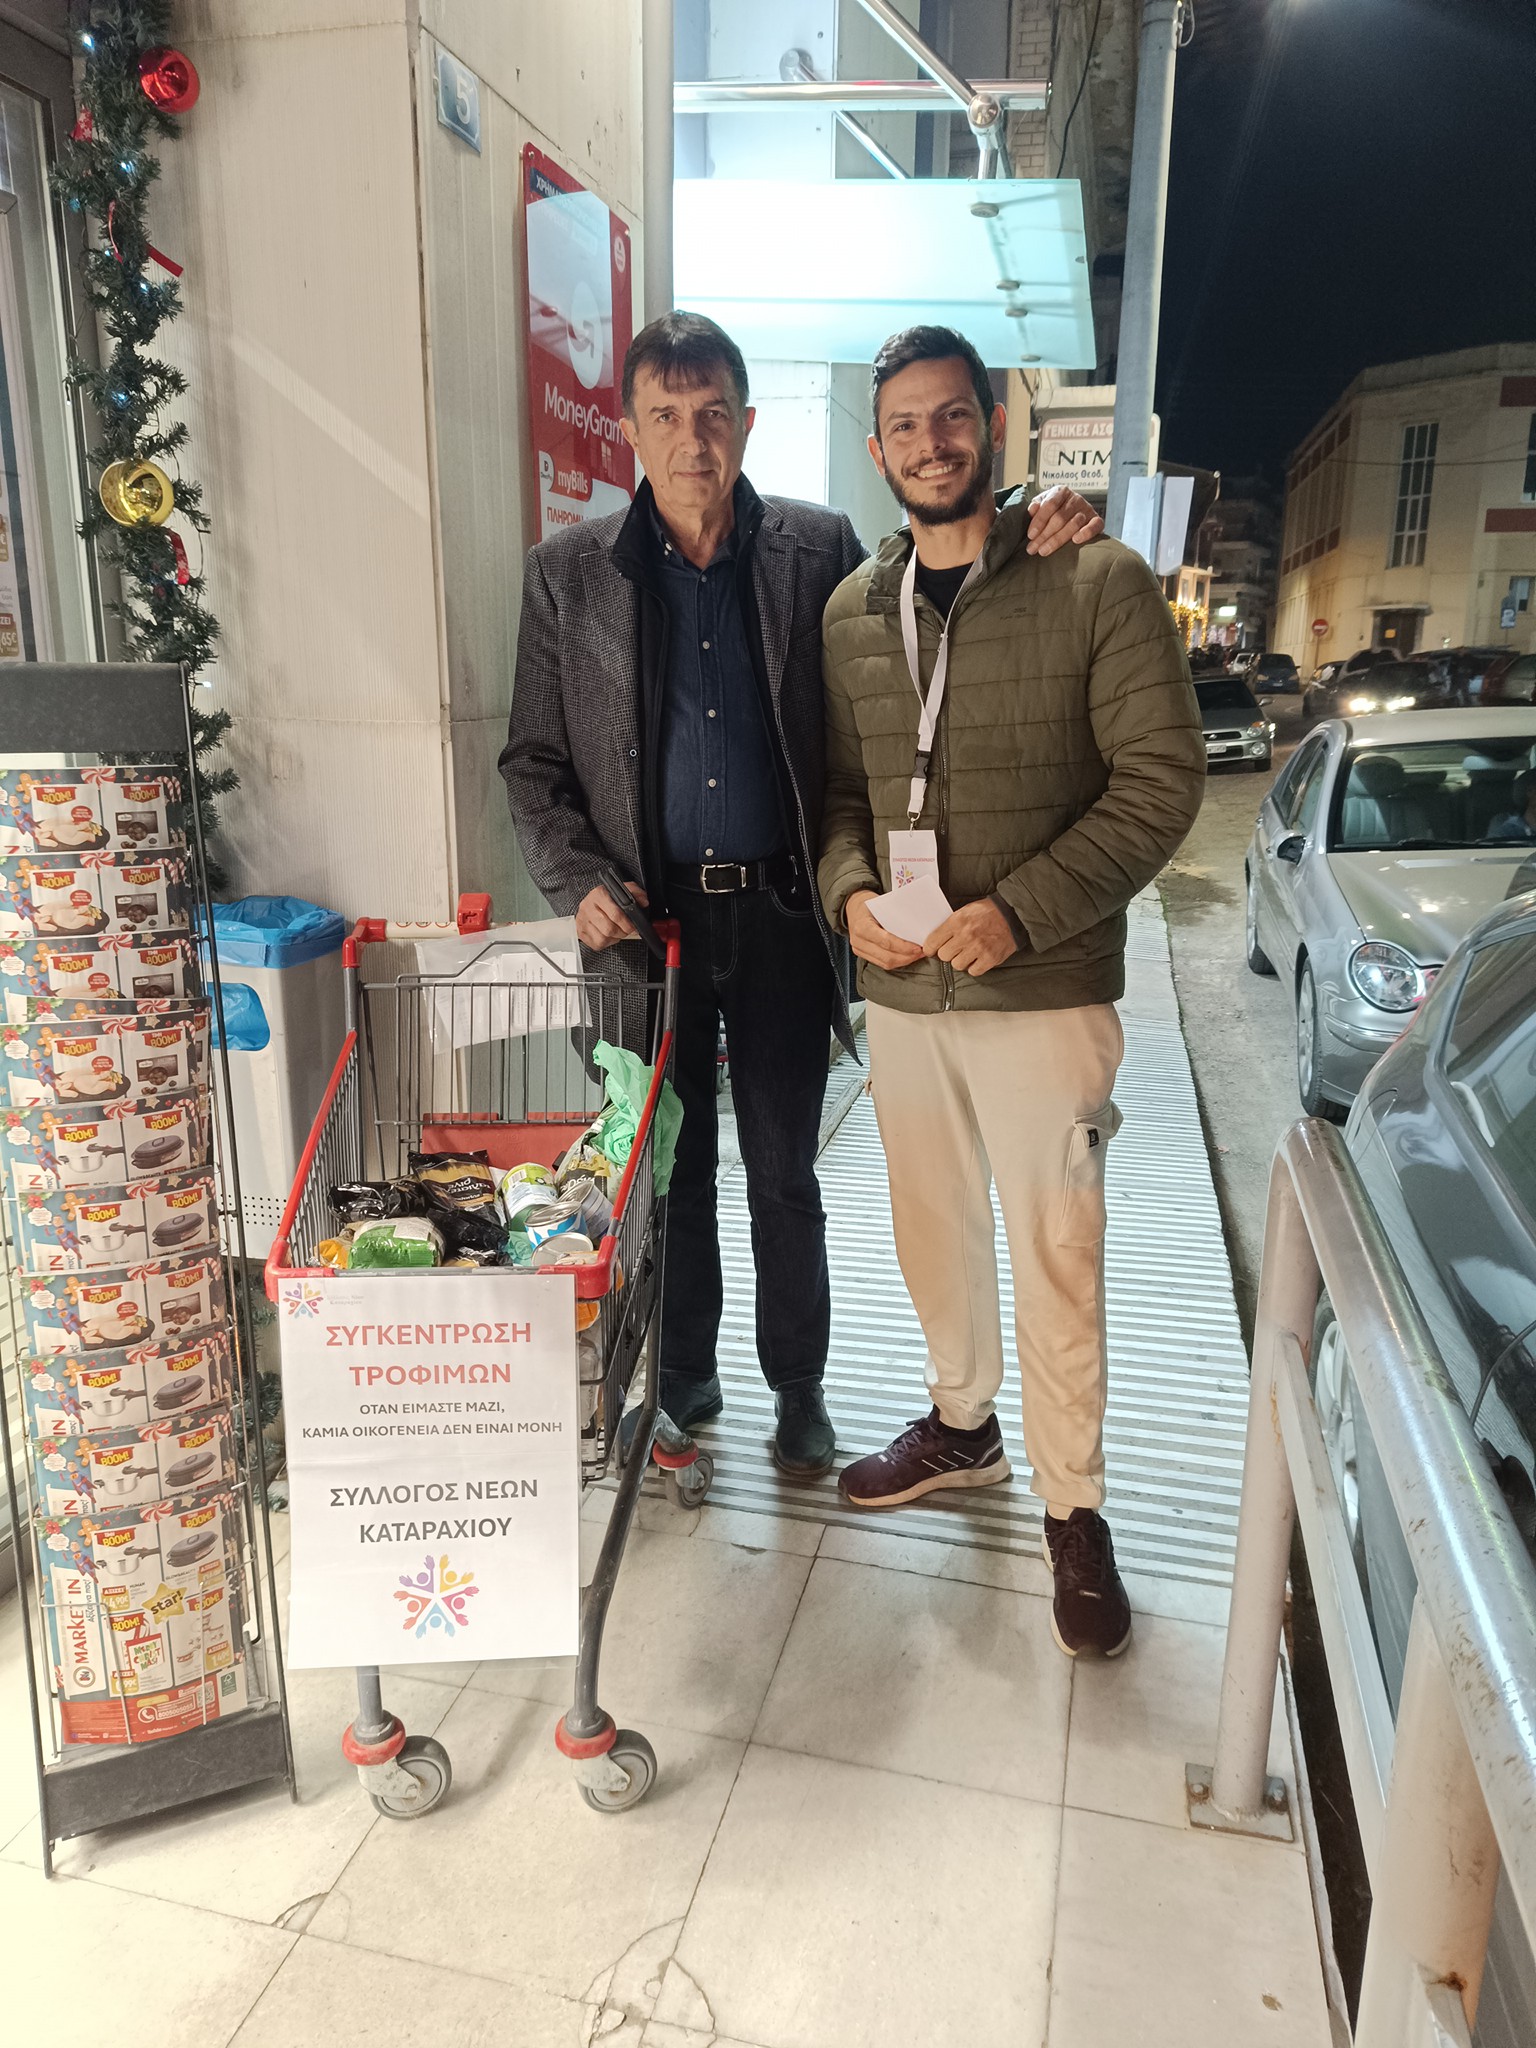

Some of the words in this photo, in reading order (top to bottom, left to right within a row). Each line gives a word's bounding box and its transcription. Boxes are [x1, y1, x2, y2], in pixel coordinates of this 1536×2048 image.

[456, 73, 473, 124] 5
[545, 382, 623, 446] MoneyGram
[1044, 424, 1089, 438] ΓΕΝΙΚΕΣ
[558, 470, 588, 494] myBills
[42, 792, 72, 803] BOOM!
[129, 790, 156, 800] BOOM!
[41, 876, 70, 888] BOOM!
[128, 872, 156, 884] BOOM!
[59, 959, 88, 972] BOOM!
[146, 952, 173, 966] BOOM!
[150, 1035, 177, 1048] BOOM!
[62, 1043, 93, 1056] BOOM!
[150, 1116, 178, 1130] BOOM!
[64, 1128, 94, 1142] BOOM!
[172, 1194, 199, 1208] BOOM!
[86, 1209, 116, 1222] BOOM!
[174, 1273, 200, 1288] BOOM!
[88, 1290, 118, 1304] BOOM!
[326, 1322, 532, 1347] ΣΥΓΚΕΝΤΡΩΣΗ
[172, 1356, 199, 1371] BOOM!
[88, 1374, 118, 1388] BOOM!
[349, 1364, 512, 1387] ΤΡΟΦΙΜΩΝ
[359, 1402, 398, 1415] ΟΤΑΝ
[402, 1401, 462, 1414] ΕΙΜΑΣΤΕ
[466, 1401, 505, 1414] ΜΑΖΙ,
[302, 1426, 349, 1438] ΚΑΜΙΑ
[352, 1425, 440, 1437] ΟΙΚΟΓΕΝΕΙΑ
[442, 1424, 472, 1435] ΔΕΝ
[476, 1423, 514, 1434] ΕΙΝΑΙ
[517, 1422, 562, 1434] ΜΟΝΗ
[184, 1432, 210, 1448] BOOM!
[100, 1453, 130, 1466] BOOM!
[330, 1483, 458, 1506] ΣΥΛΛΟΓΟΣ
[466, 1479, 538, 1500] ΝΕΩΝ
[186, 1510, 212, 1528] BOOM!
[359, 1517, 512, 1543] ΚΑΤΑΡΑΧΙΟΥ
[102, 1534, 130, 1546] BOOM!
[67, 1579, 81, 1594] IN
[150, 1590, 183, 1614] star!
[112, 1617, 140, 1630] BOOM!
[134, 1642, 157, 1655] MERRY
